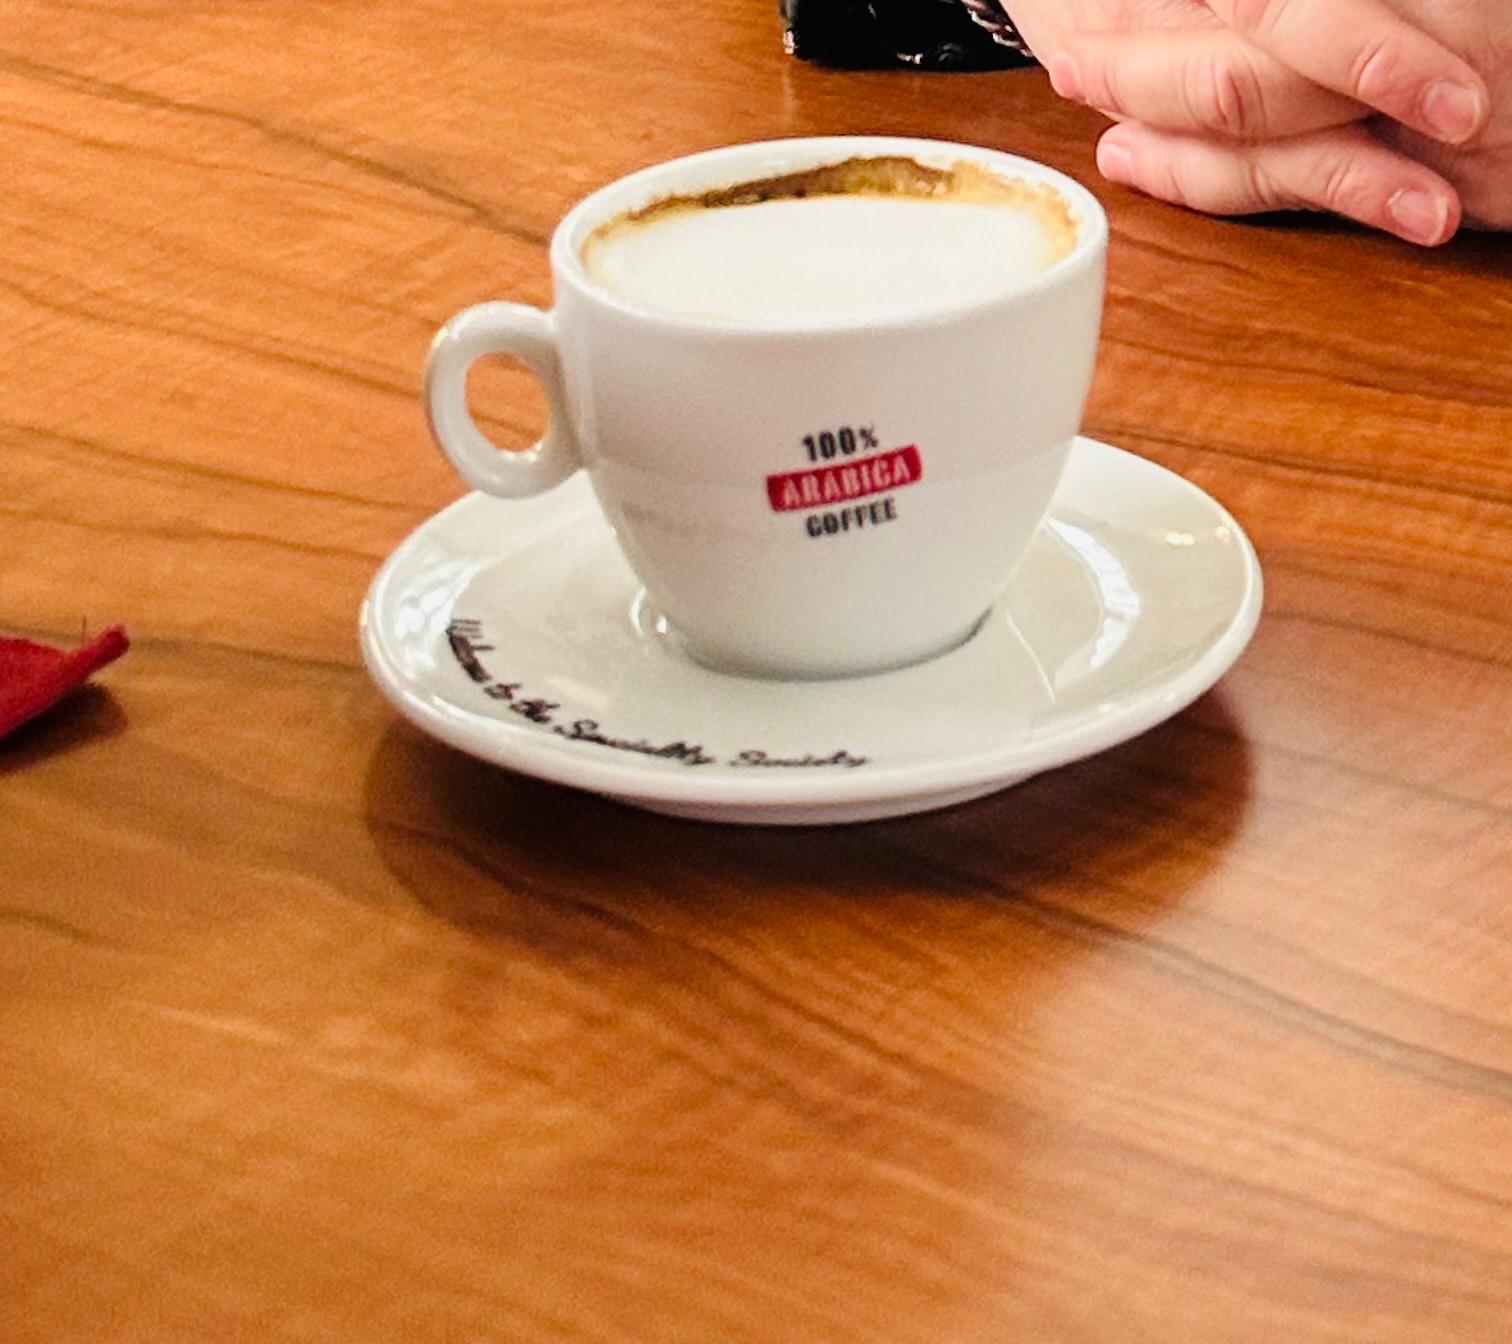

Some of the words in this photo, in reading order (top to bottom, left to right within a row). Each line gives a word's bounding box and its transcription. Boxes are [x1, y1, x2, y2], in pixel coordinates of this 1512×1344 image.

[802, 424, 879, 462] 100%
[781, 453, 912, 508] ARABICA
[806, 496, 898, 538] COFFEE
